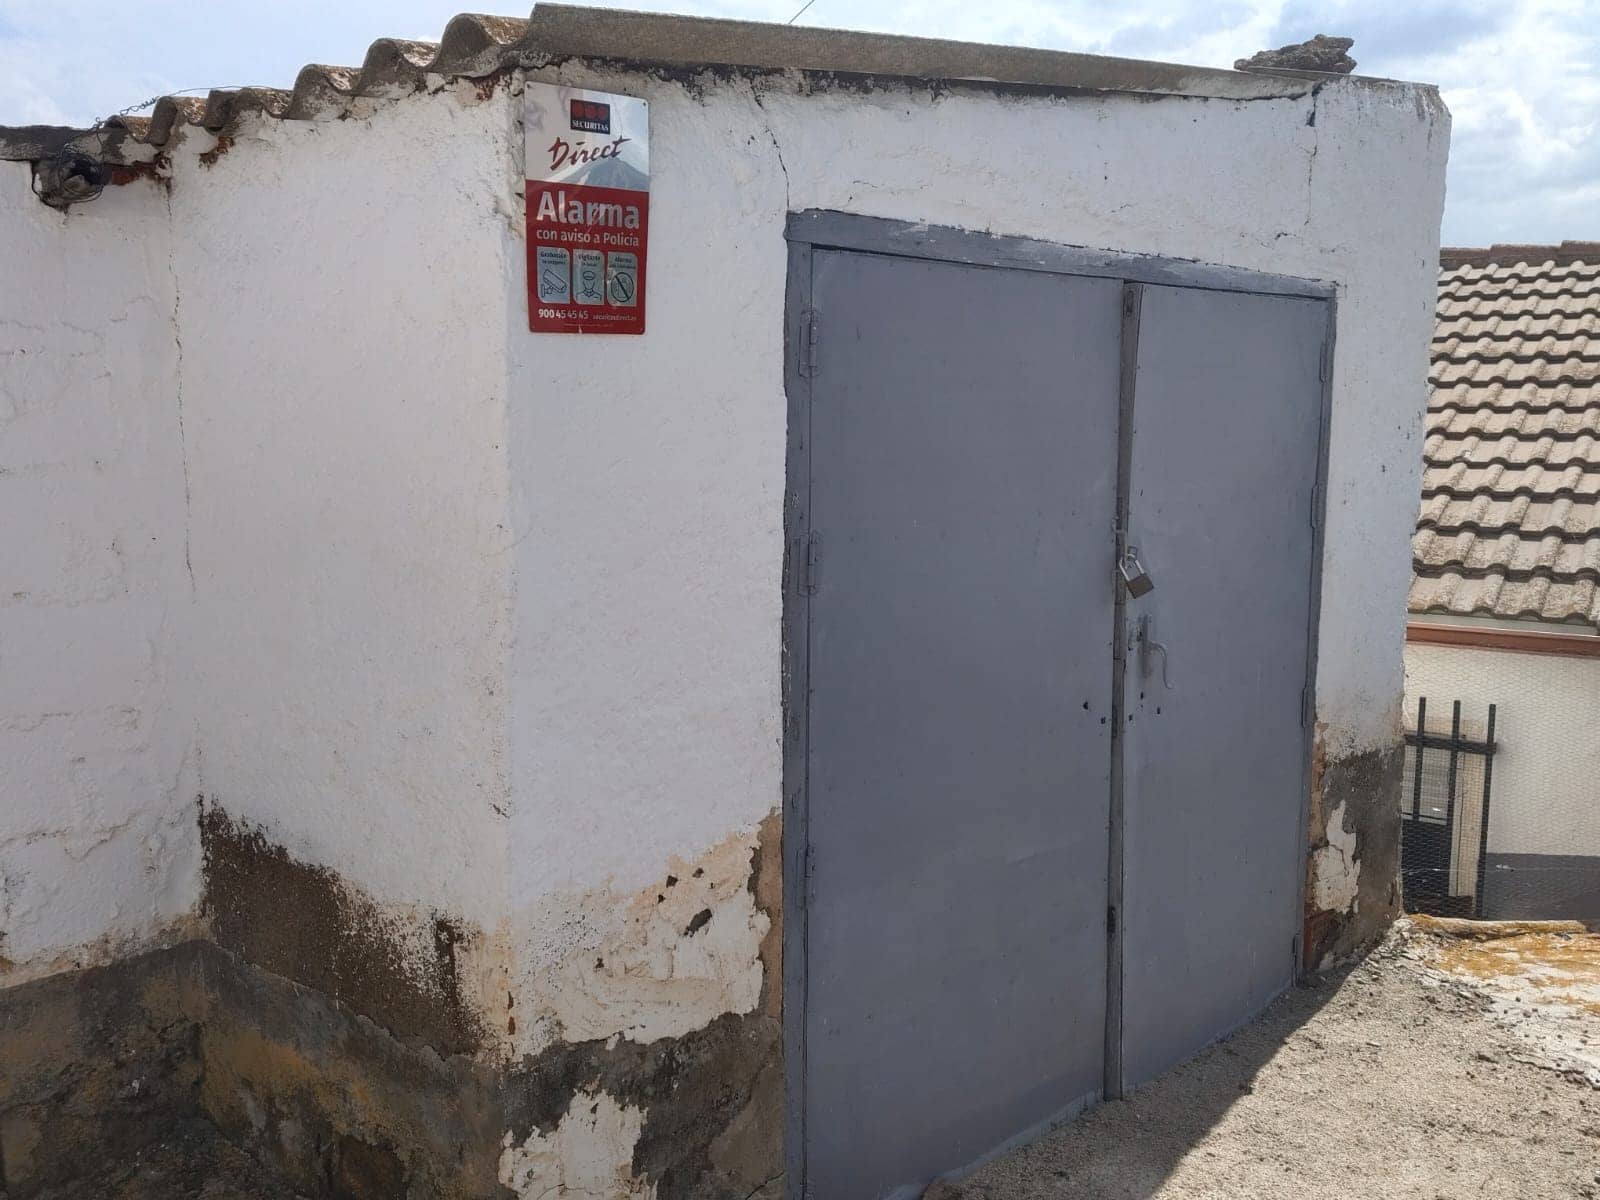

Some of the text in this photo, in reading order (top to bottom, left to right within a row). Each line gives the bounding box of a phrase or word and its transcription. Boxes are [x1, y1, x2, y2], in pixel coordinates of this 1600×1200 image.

[572, 120, 609, 131] SECURITAS
[547, 136, 632, 171] Direct
[536, 191, 639, 229] Alarma
[536, 229, 639, 247] con aviso a Policía
[538, 308, 555, 319] 900
[555, 309, 566, 319] 45
[567, 310, 577, 319] 45
